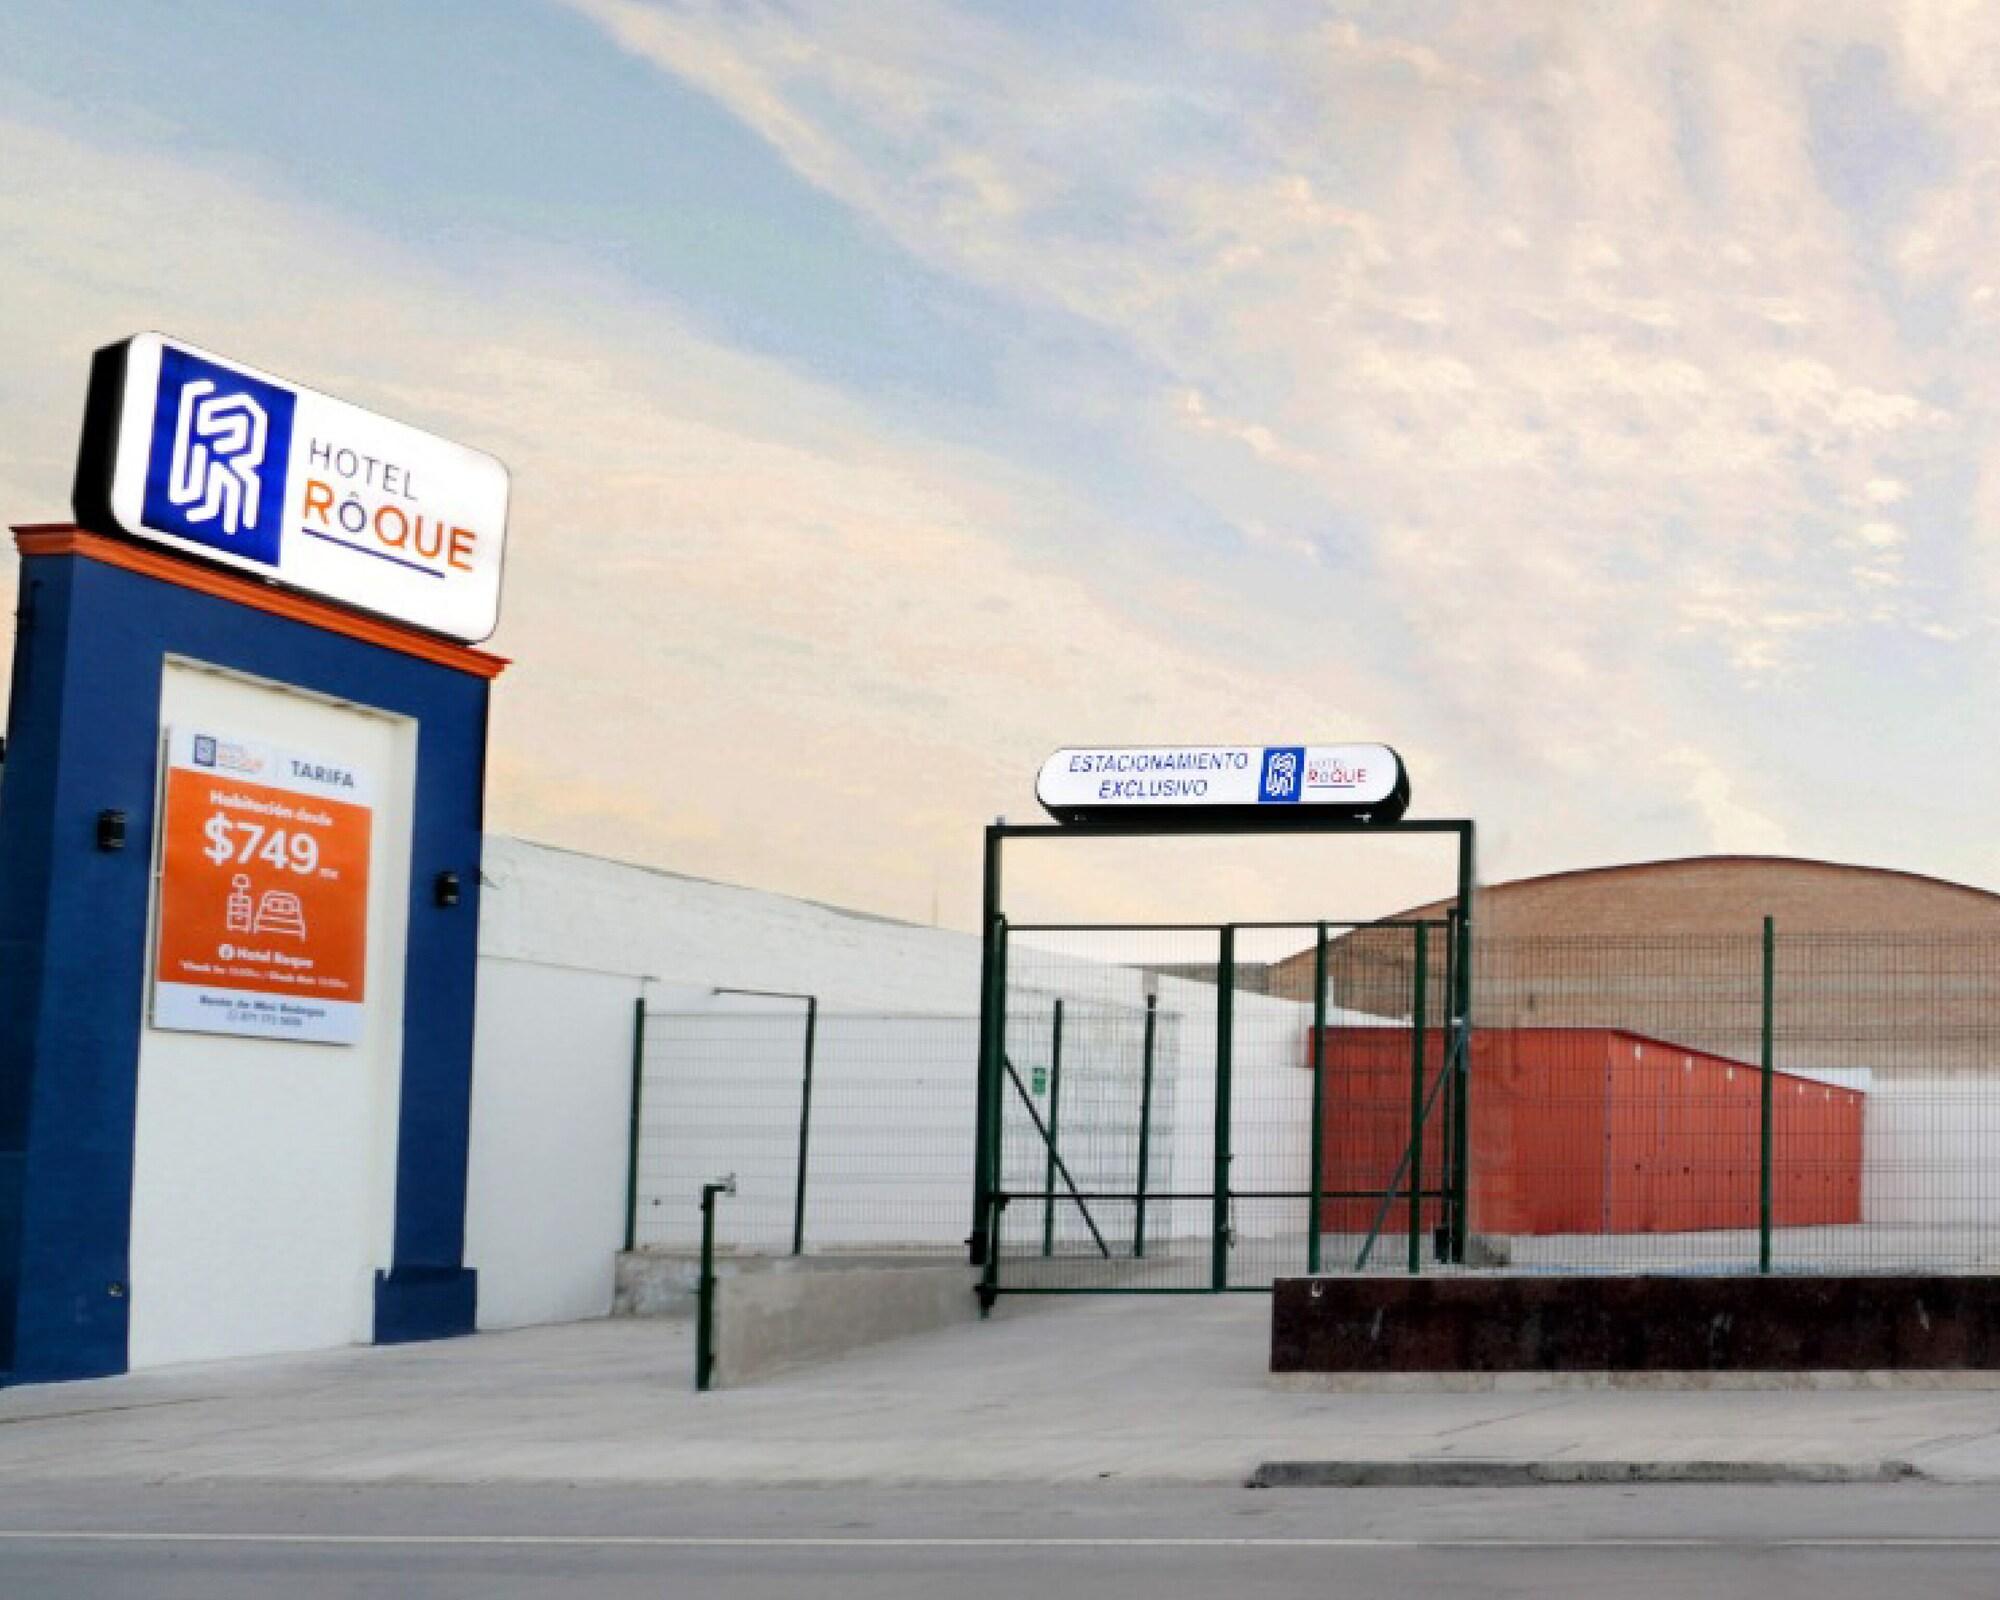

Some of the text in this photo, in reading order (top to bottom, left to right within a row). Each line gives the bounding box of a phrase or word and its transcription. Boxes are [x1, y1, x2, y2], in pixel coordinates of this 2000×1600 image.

[309, 437, 418, 501] HOTEL
[291, 760, 354, 787] TARIFA
[1069, 752, 1248, 773] ESTACIONAMIENTO
[1098, 779, 1208, 798] EXCLUSIVO
[203, 812, 319, 874] $749
